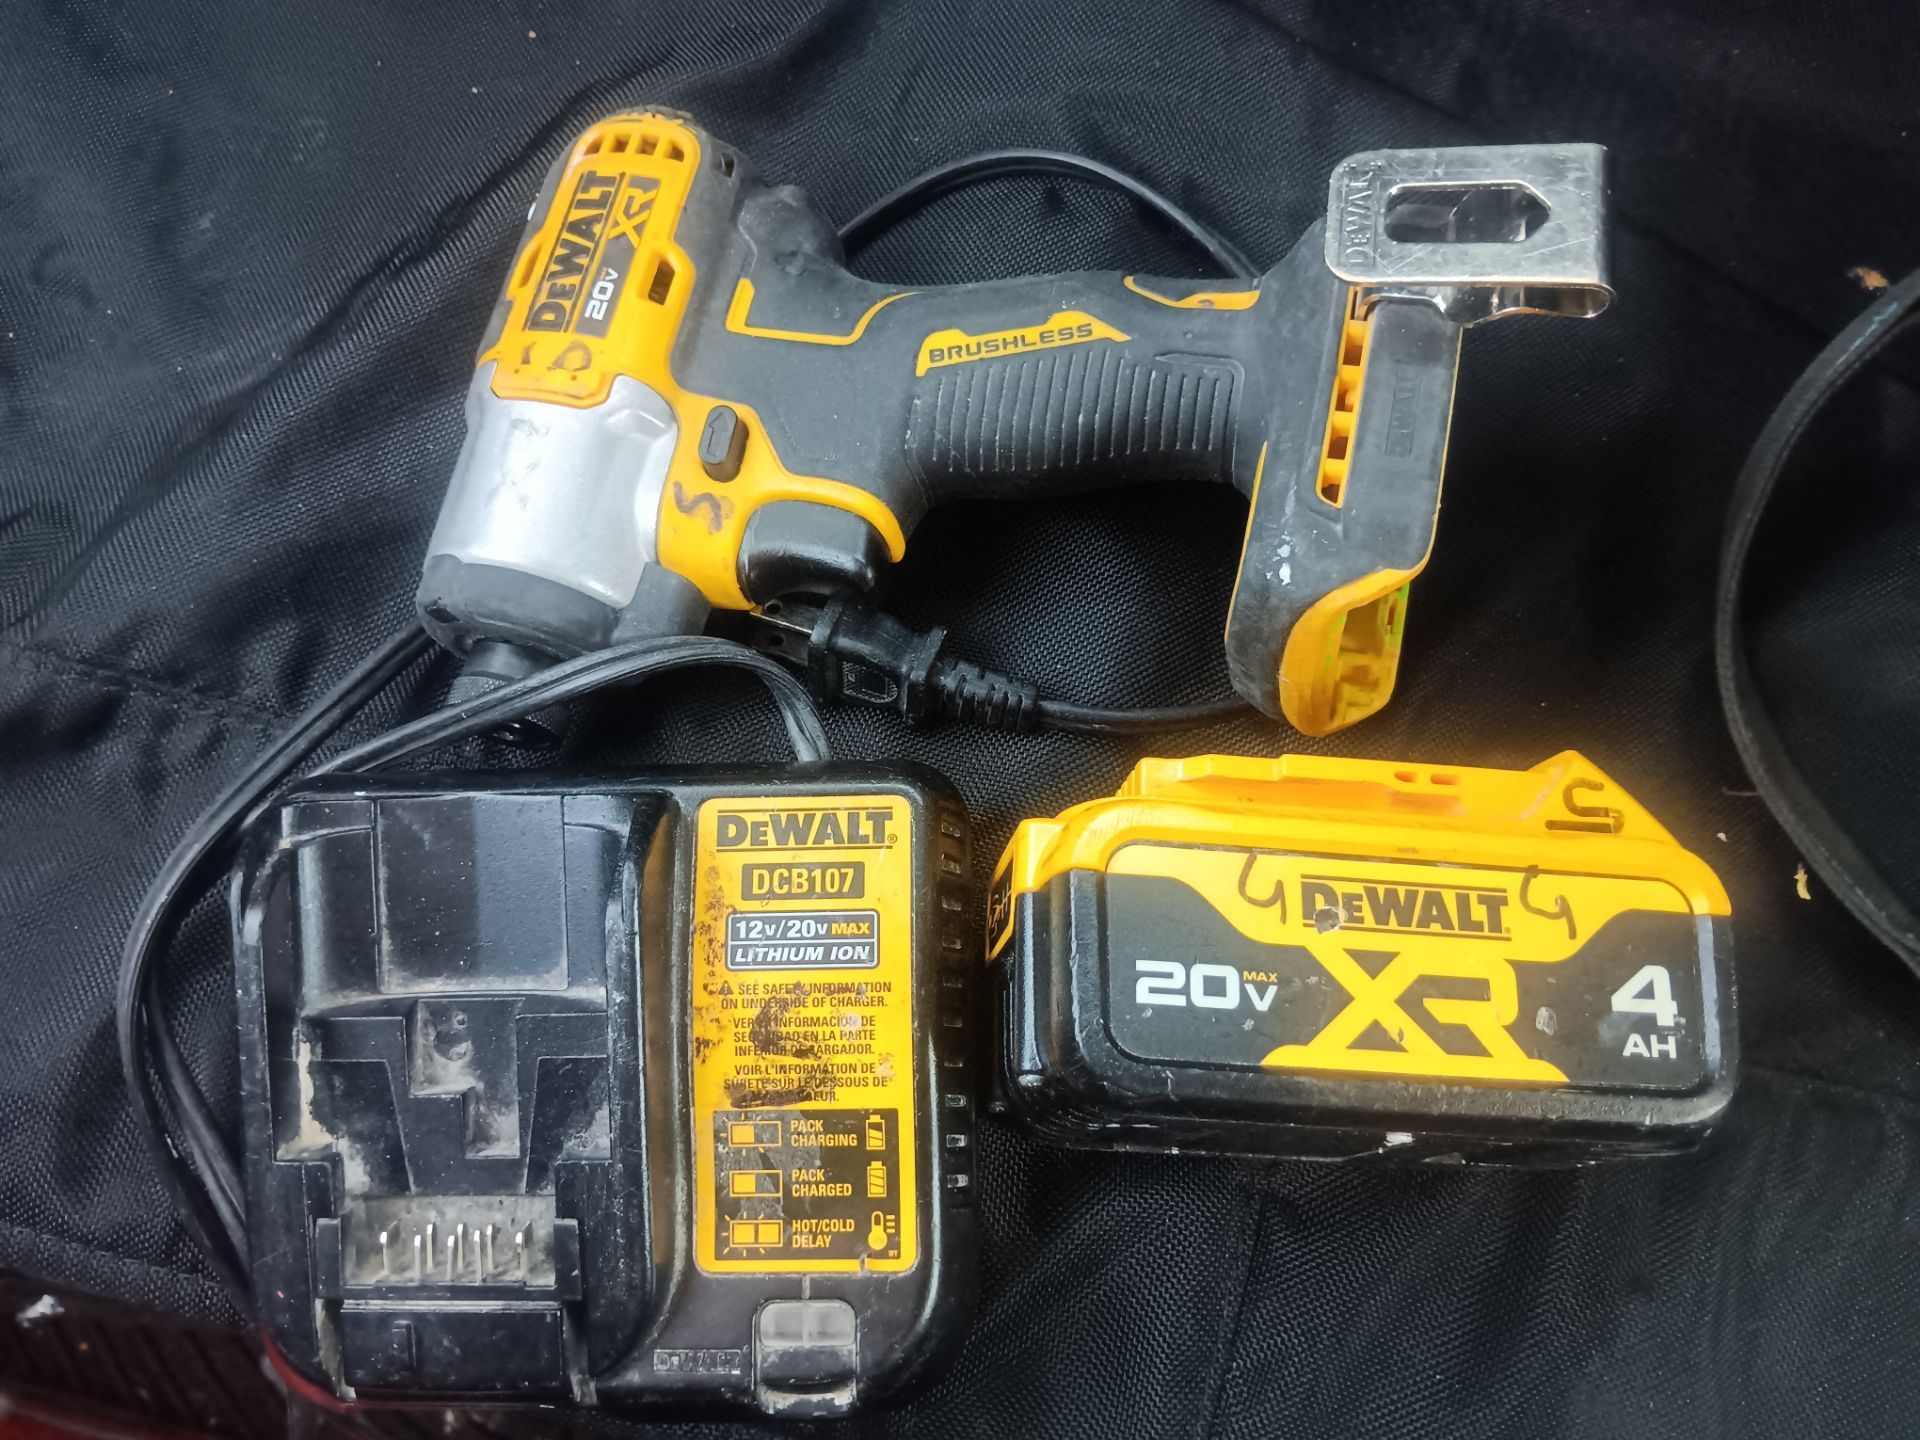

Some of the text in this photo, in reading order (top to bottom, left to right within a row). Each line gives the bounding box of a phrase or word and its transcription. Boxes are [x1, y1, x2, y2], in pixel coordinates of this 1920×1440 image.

[608, 187, 660, 249] XR
[929, 323, 1093, 363] BRUSHLESS
[752, 868, 855, 894] DCB107
[831, 922, 870, 935] MAX
[735, 945, 871, 962] LITHIUM ION
[1243, 970, 1278, 983] MAX
[738, 983, 759, 995] SEE
[809, 981, 892, 994] INFORMATION
[721, 998, 738, 1009] ON
[812, 996, 826, 1008] OF
[830, 995, 888, 1008] CHARGER.
[1305, 945, 1529, 1058] XR
[1611, 964, 1678, 1027] 4
[733, 1017, 754, 1029] VER
[861, 1015, 876, 1027] DE
[734, 1029, 876, 1043] SEIDAD EN LA PARTE
[811, 1043, 875, 1056] ARGADOR.
[1622, 1033, 1677, 1059] AH
[735, 1062, 876, 1076] VOIR L'INFORMATION DE
[772, 1077, 795, 1089] SUR
[815, 1076, 869, 1088] DESSOUS
[790, 1120, 823, 1132] PACK
[790, 1134, 858, 1147] CHARGING
[791, 1170, 825, 1182] PACK
[791, 1183, 852, 1197] CHARGED
[792, 1219, 855, 1233] HOT/COLD
[792, 1235, 832, 1248] DELAY
